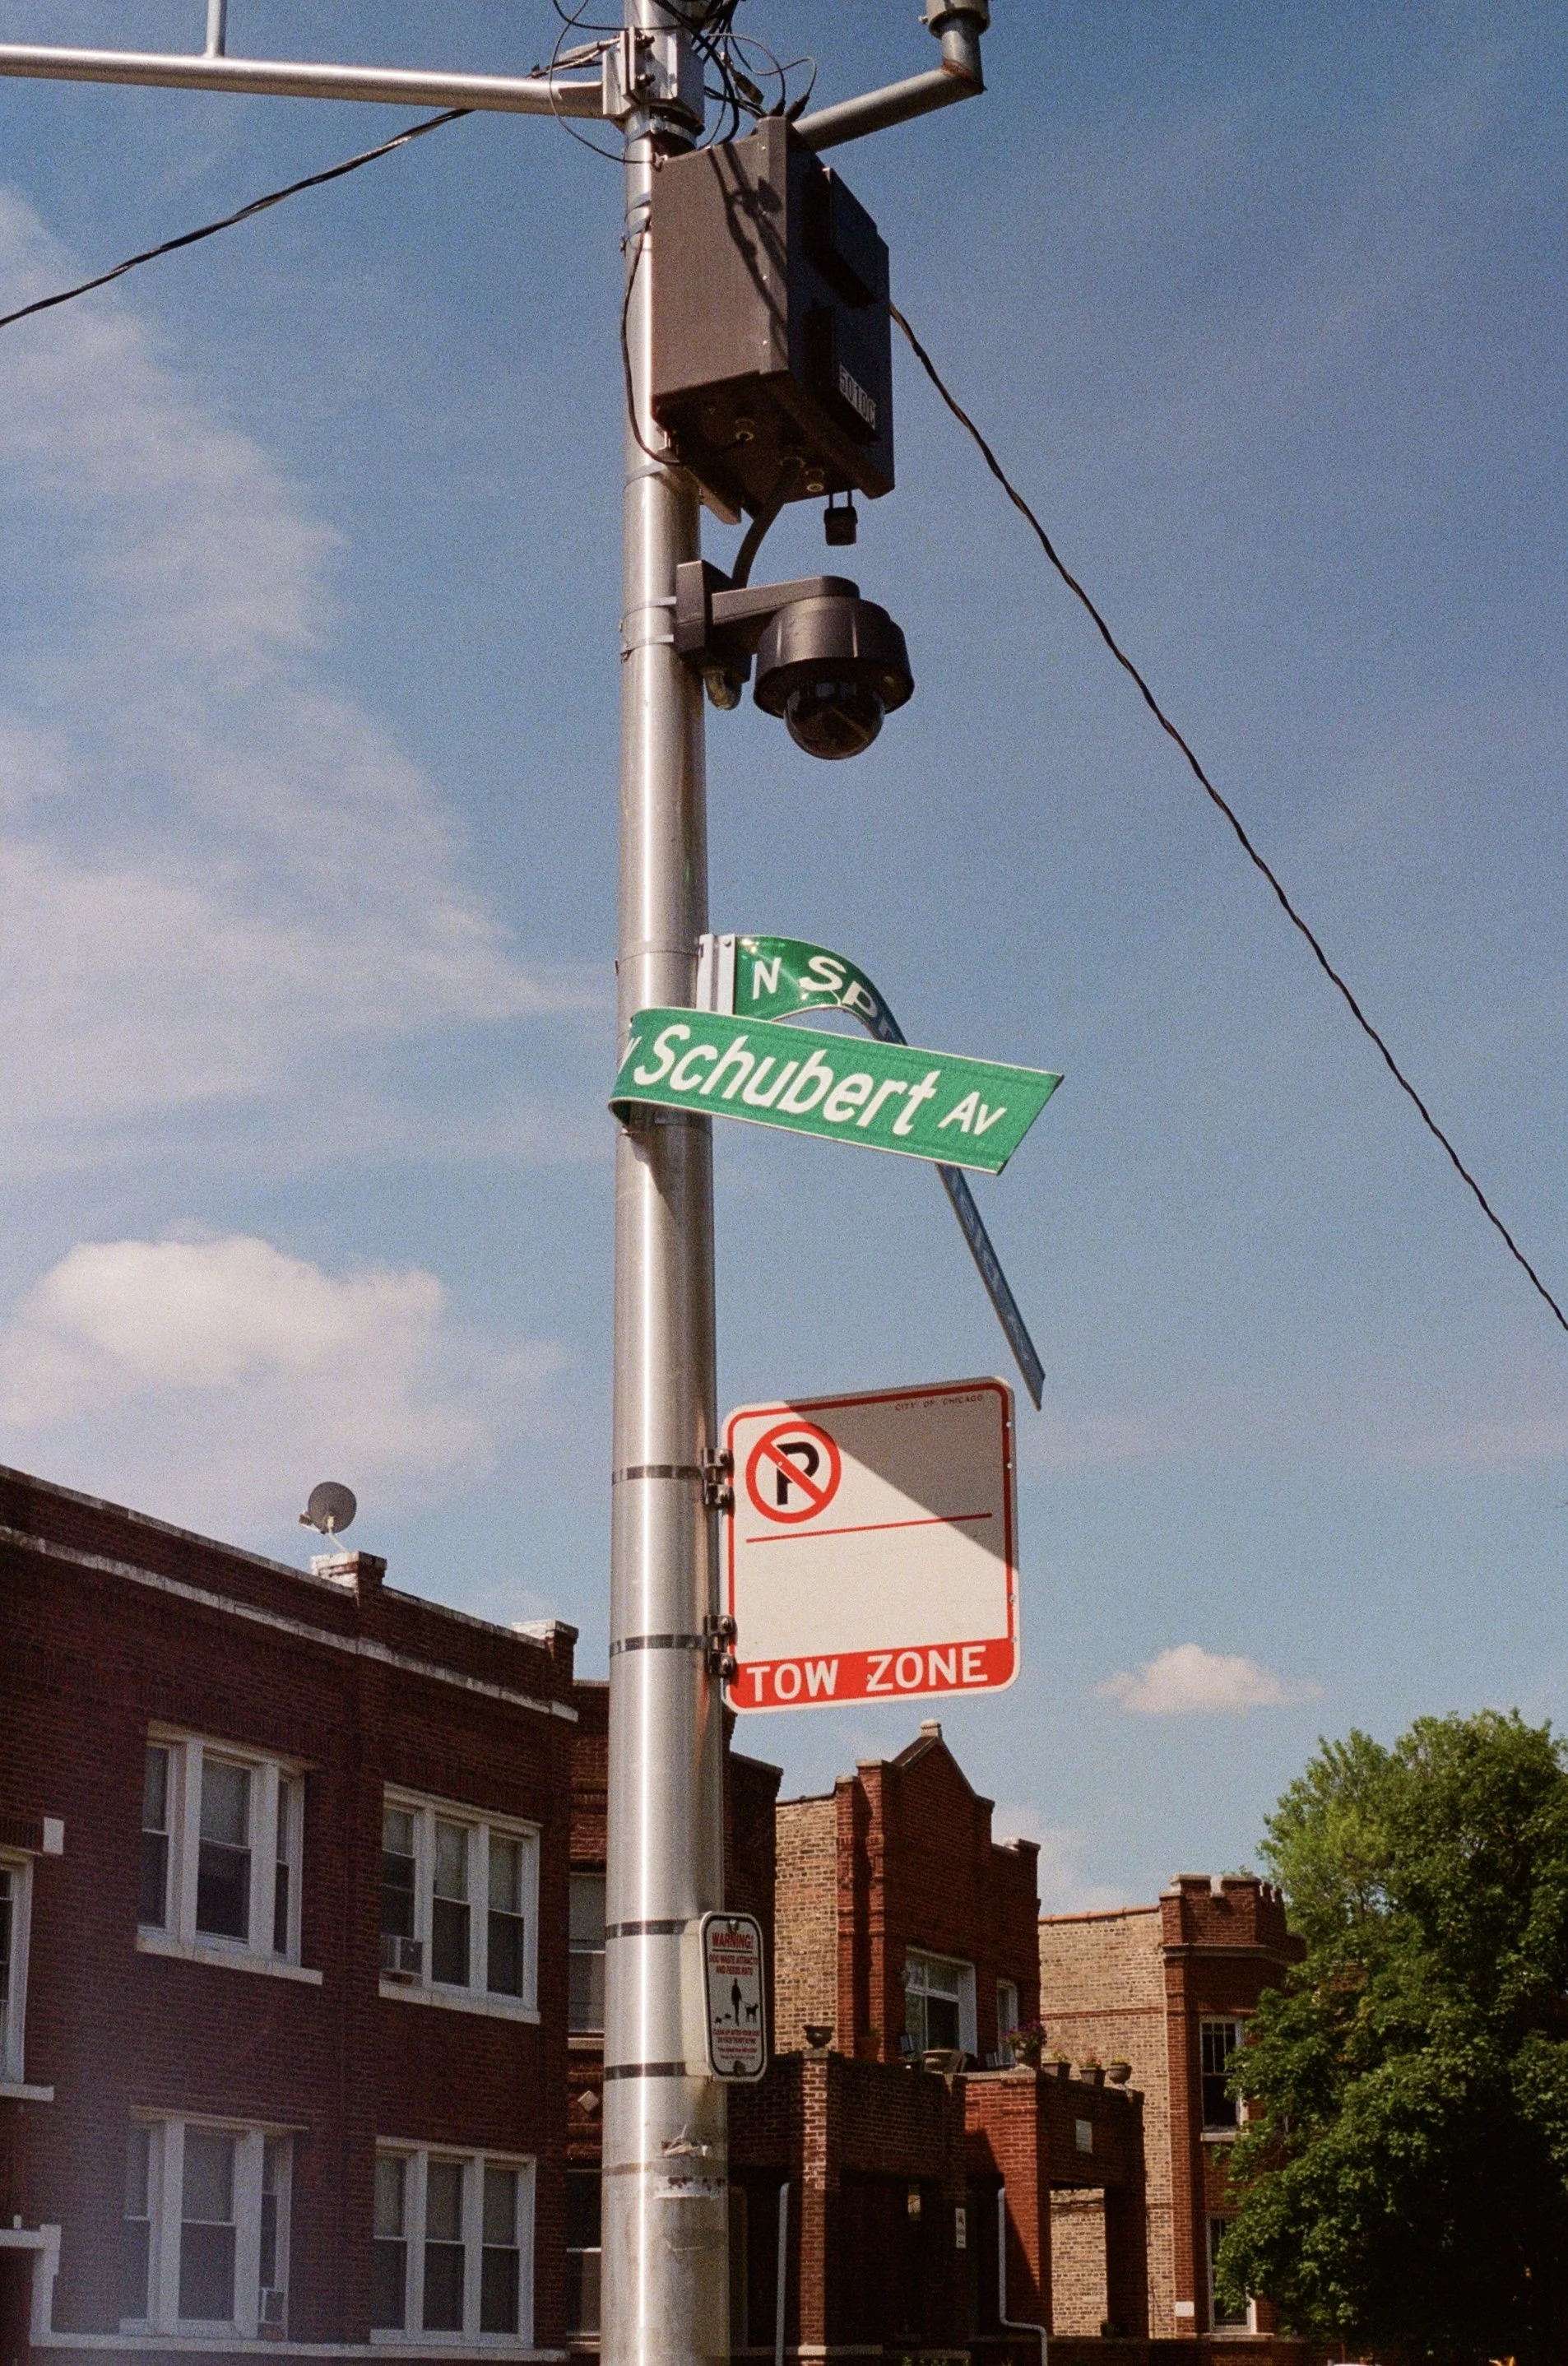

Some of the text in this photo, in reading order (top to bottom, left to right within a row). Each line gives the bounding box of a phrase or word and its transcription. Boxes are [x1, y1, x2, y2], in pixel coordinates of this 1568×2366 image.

[752, 957, 782, 1000] N
[633, 1024, 940, 1136] Schubert
[938, 1091, 1007, 1136] Av
[895, 1394, 983, 1411] CITY OF CHICAGO
[746, 1645, 989, 1702] TOW ZONE
[712, 1932, 754, 1949] WARNING!
